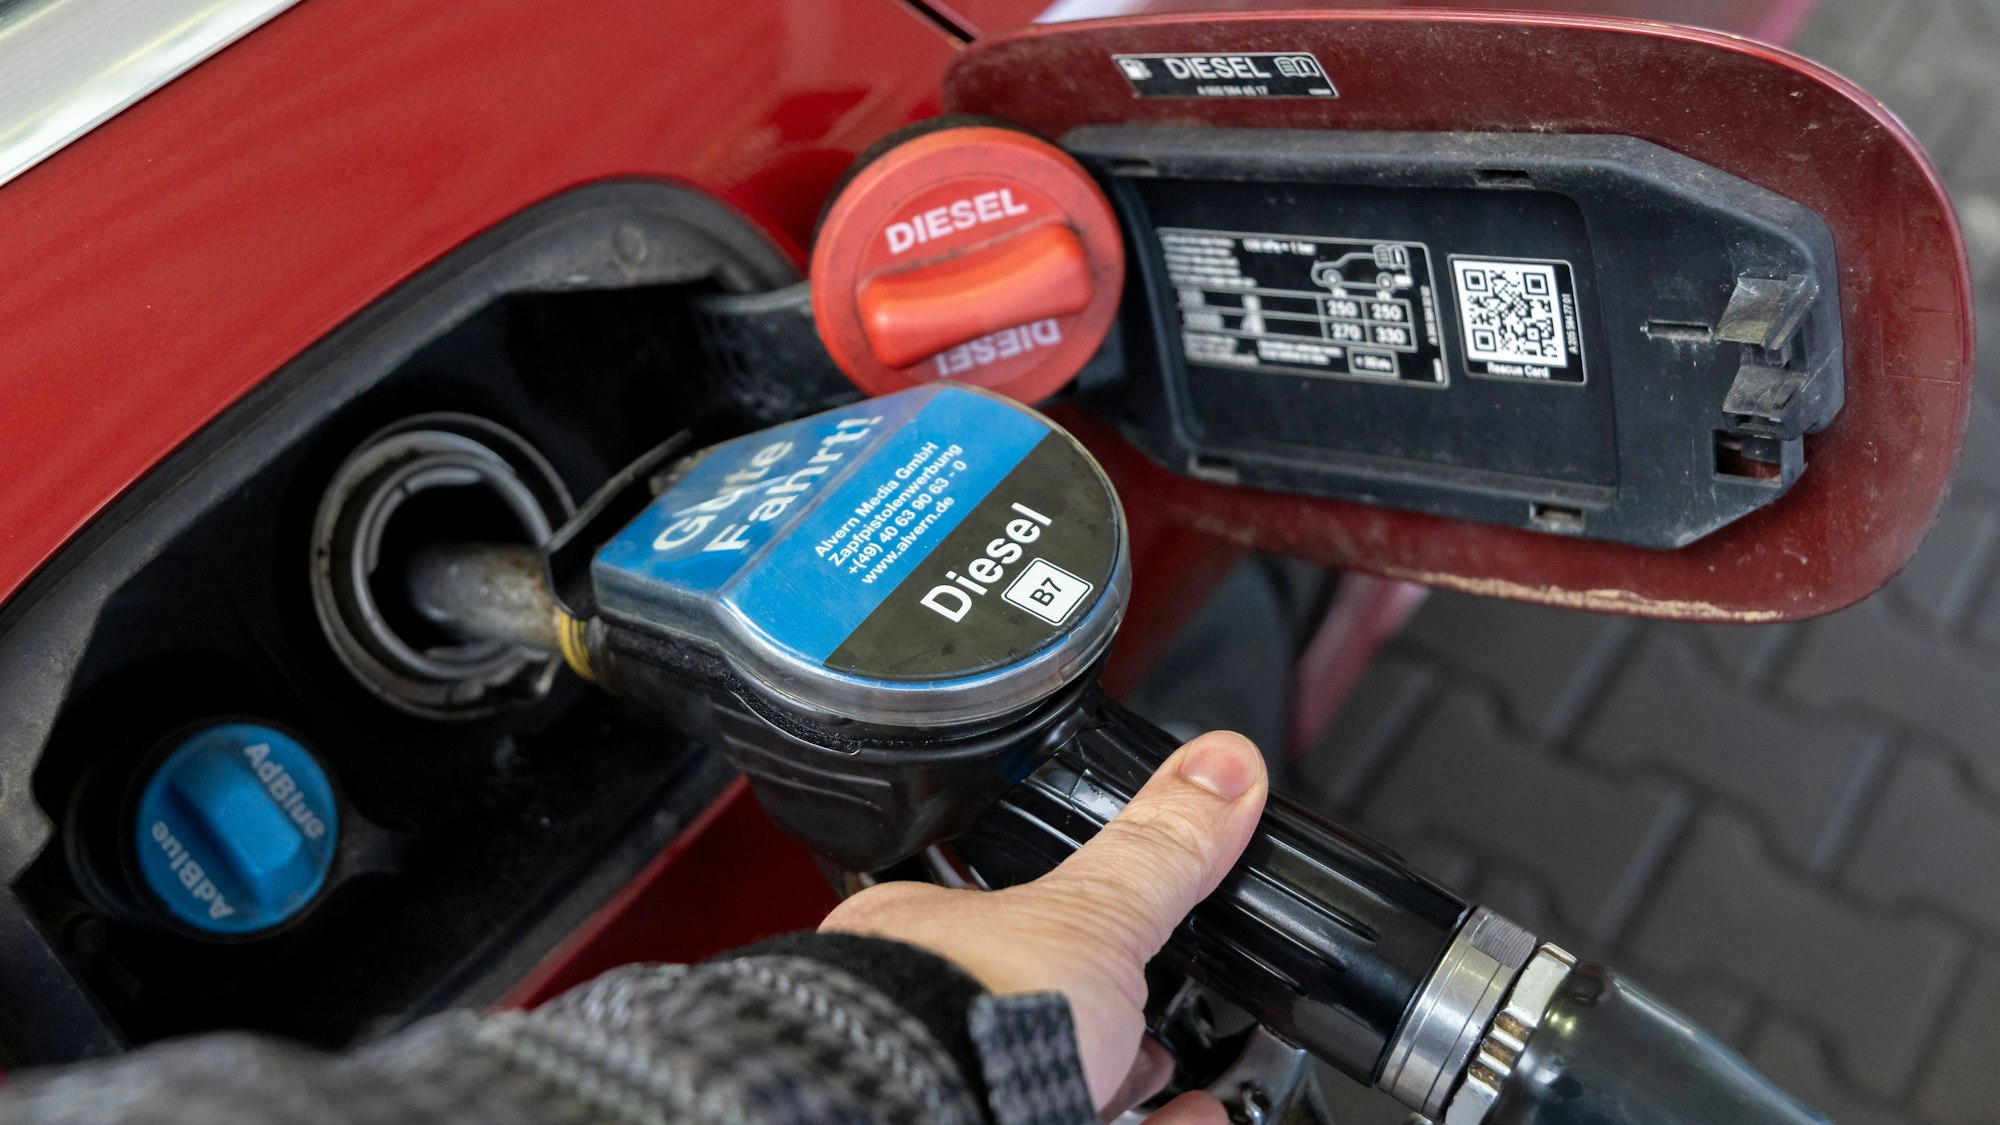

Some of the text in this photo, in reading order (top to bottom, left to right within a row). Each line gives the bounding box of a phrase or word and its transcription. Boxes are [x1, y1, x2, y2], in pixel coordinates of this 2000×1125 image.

[1163, 57, 1272, 79] DIESEL
[884, 188, 1029, 255] DIESEL
[1327, 300, 1403, 321] 250 250
[1331, 322, 1407, 345] 270 330
[1487, 361, 1550, 379] Rescue Card
[653, 441, 794, 551] Gute
[702, 416, 883, 552] Fahrt!
[815, 441, 939, 557] Alvern Media GmbH
[828, 444, 963, 567] Zapfpistolenwerbung
[849, 543, 883, 574] +(49)
[879, 526, 898, 543] 40
[894, 509, 916, 527] 63
[911, 493, 933, 511] 90
[928, 477, 949, 494] 63
[952, 460, 967, 471] 0
[862, 497, 955, 584] www.alvern.de
[920, 502, 1052, 623] Diesel
[1029, 577, 1062, 607] B7
[244, 743, 325, 838] AdBlue
[151, 820, 236, 920] AdBlue
